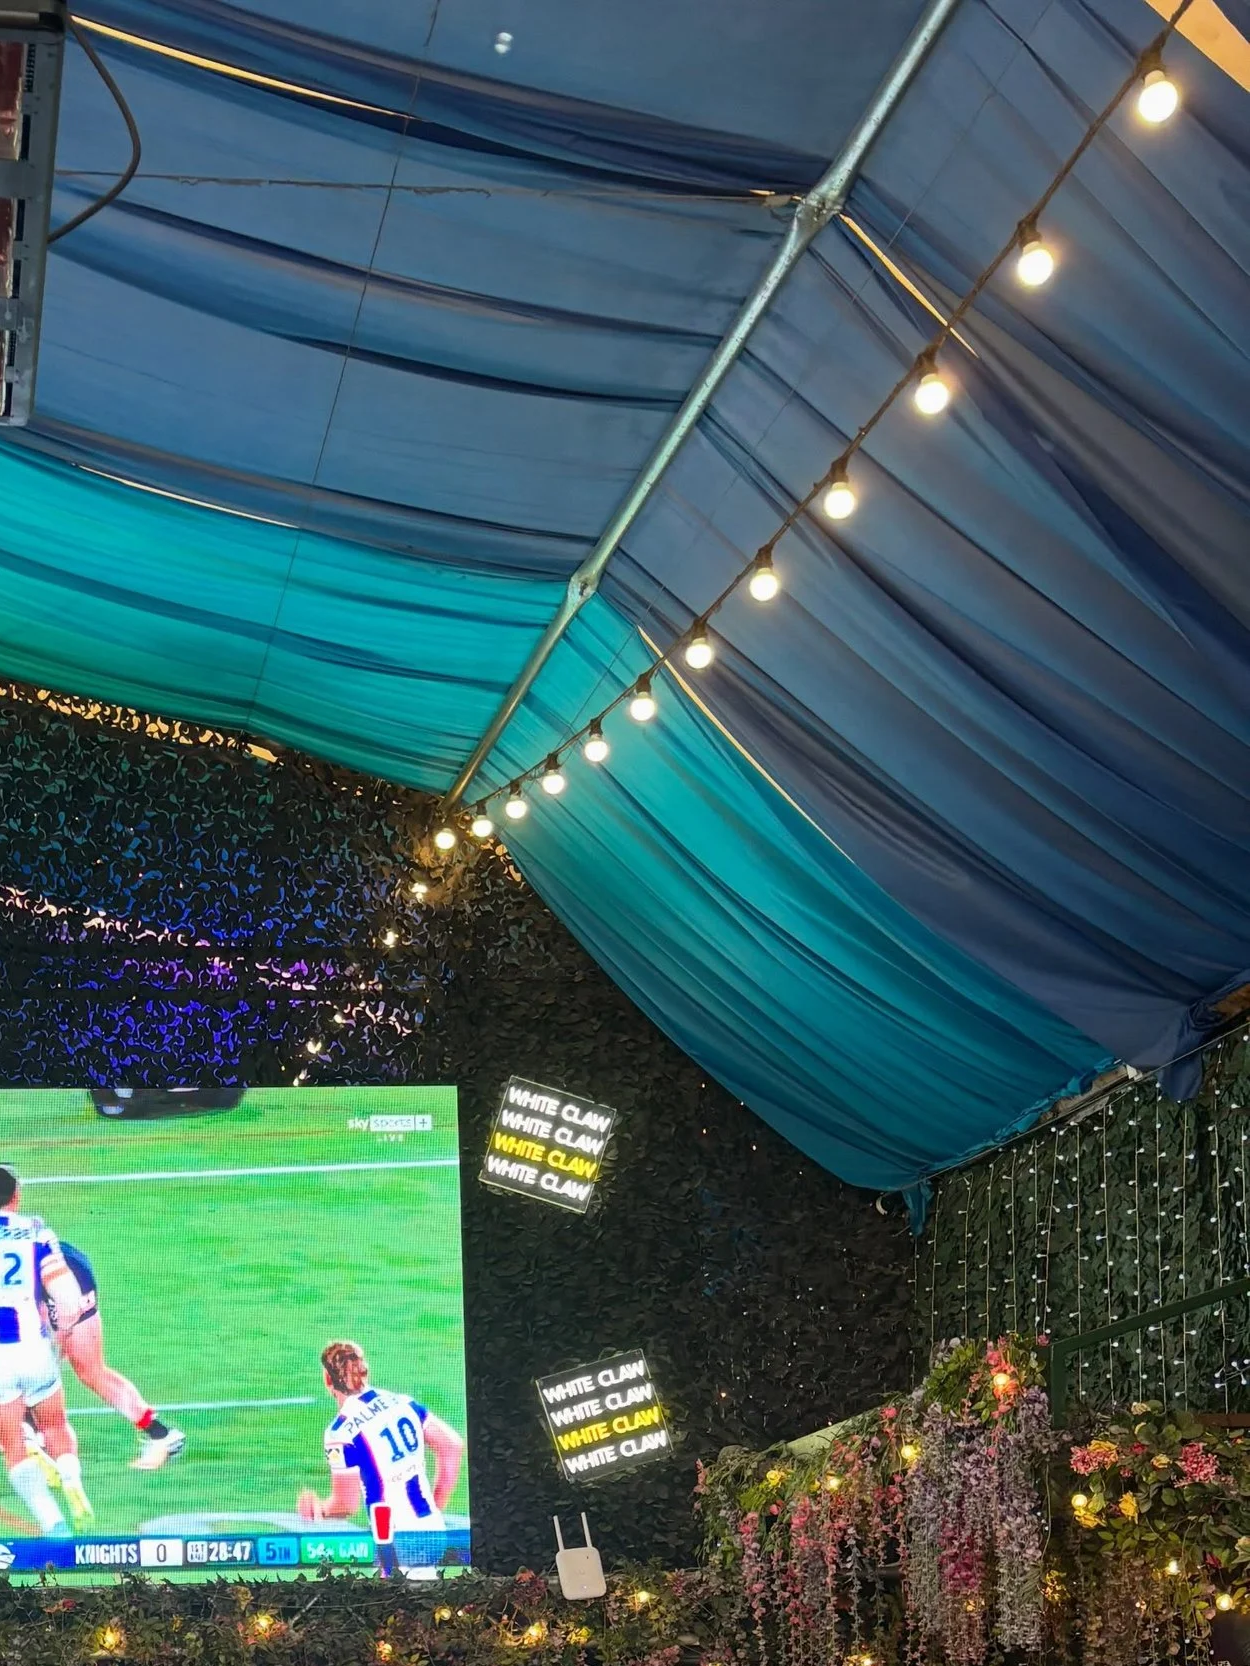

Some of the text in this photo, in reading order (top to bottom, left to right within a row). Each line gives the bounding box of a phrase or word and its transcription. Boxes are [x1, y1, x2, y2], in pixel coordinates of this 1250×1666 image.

[509, 1086, 611, 1133] WHITE CLAW
[502, 1109, 604, 1156] WHITE CLAW
[494, 1132, 597, 1178] WHITE CLAW
[487, 1155, 591, 1201] WHITE CLAW
[542, 1360, 644, 1404] WHITE CLAW
[550, 1383, 652, 1427] WHITE CLAW
[378, 1416, 419, 1463] 10
[558, 1406, 659, 1450] WHITE CLAW
[565, 1430, 667, 1474] WHITE CLAW
[75, 1543, 137, 1565] KNIGHTS
[156, 1543, 166, 1563] 0
[208, 1541, 251, 1562] 28:47
[265, 1541, 290, 1560] 5TH
